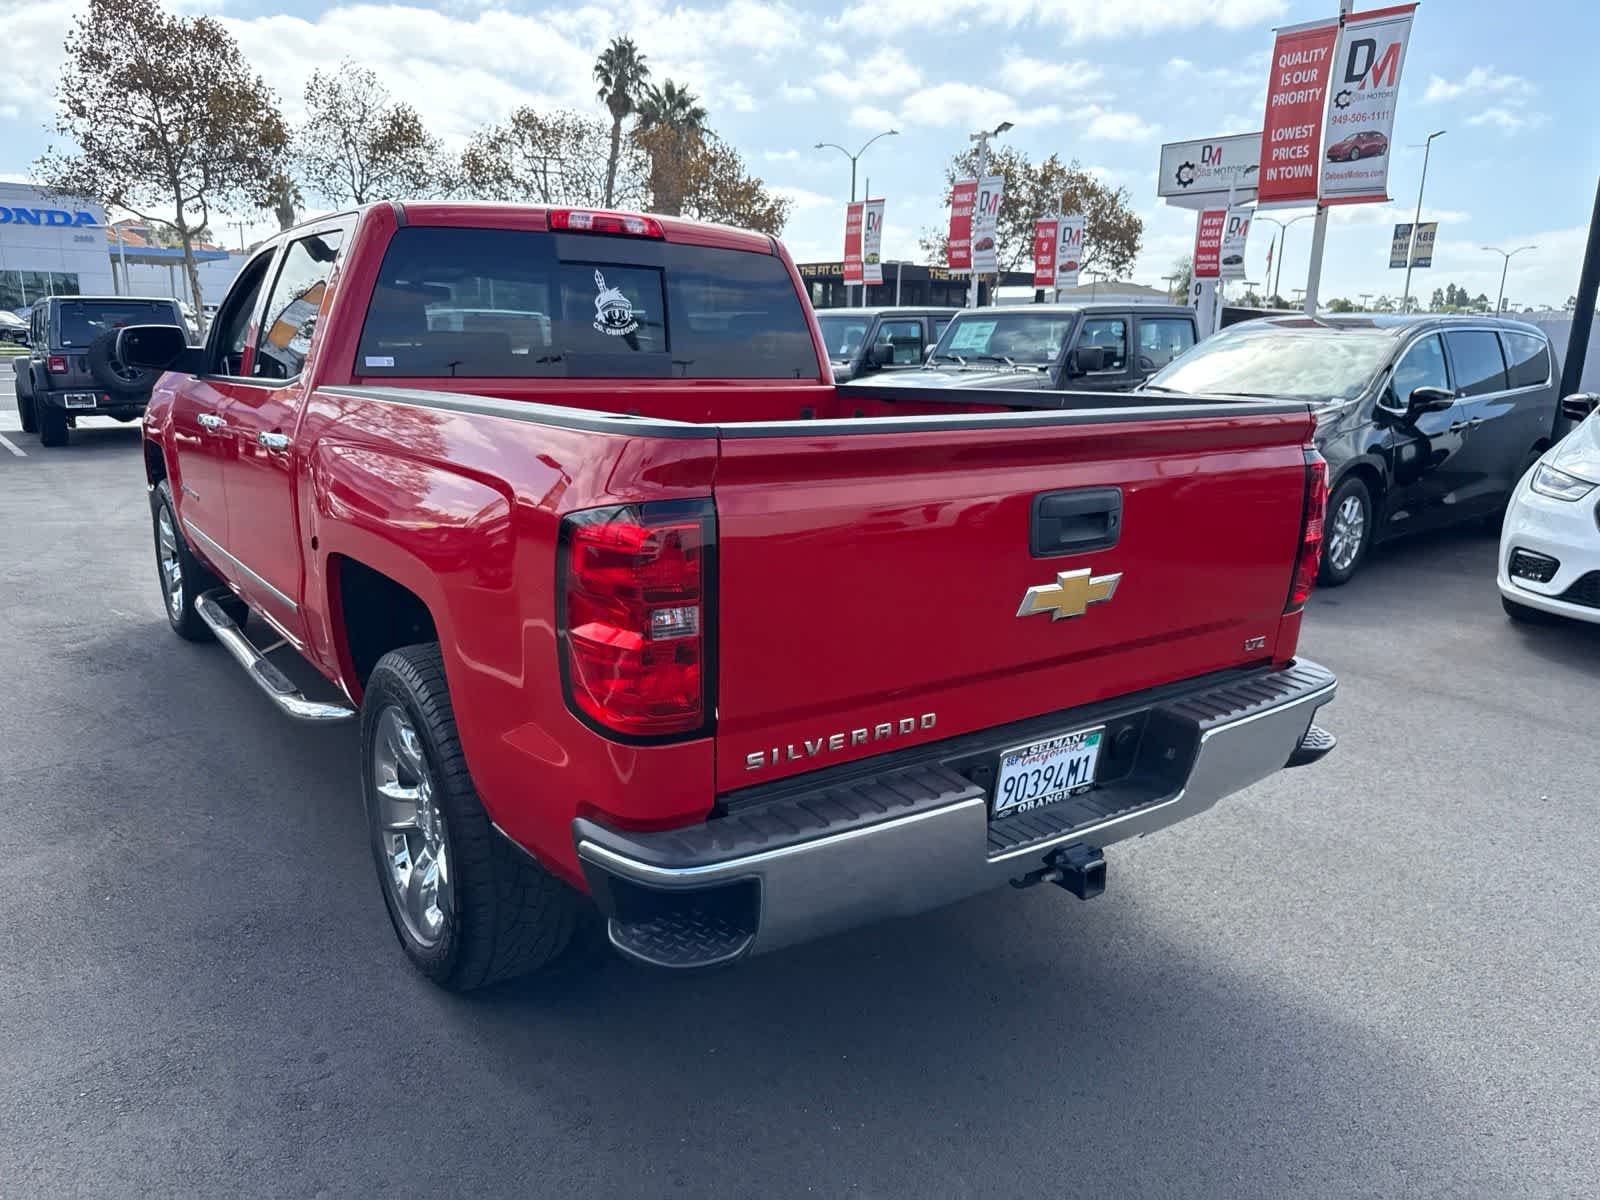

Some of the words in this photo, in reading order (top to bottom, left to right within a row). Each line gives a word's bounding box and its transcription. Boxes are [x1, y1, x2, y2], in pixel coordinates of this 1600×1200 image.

[1279, 47, 1328, 69] QUALITY
[1280, 74, 1291, 87] IS
[1293, 69, 1318, 84] OUR
[1272, 88, 1322, 107] PRIORITY
[1271, 124, 1315, 142] LOWEST
[1272, 145, 1310, 161] PRICES
[1266, 168, 1279, 181] IN
[1280, 164, 1313, 179] TOWN
[800, 266, 816, 276] THE
[817, 265, 830, 275] FIT
[745, 712, 937, 770] SILVERADO
[1029, 734, 1081, 756] SELMAN
[1000, 755, 1090, 809] 90394M1
[1017, 790, 1071, 813] ORANGE
